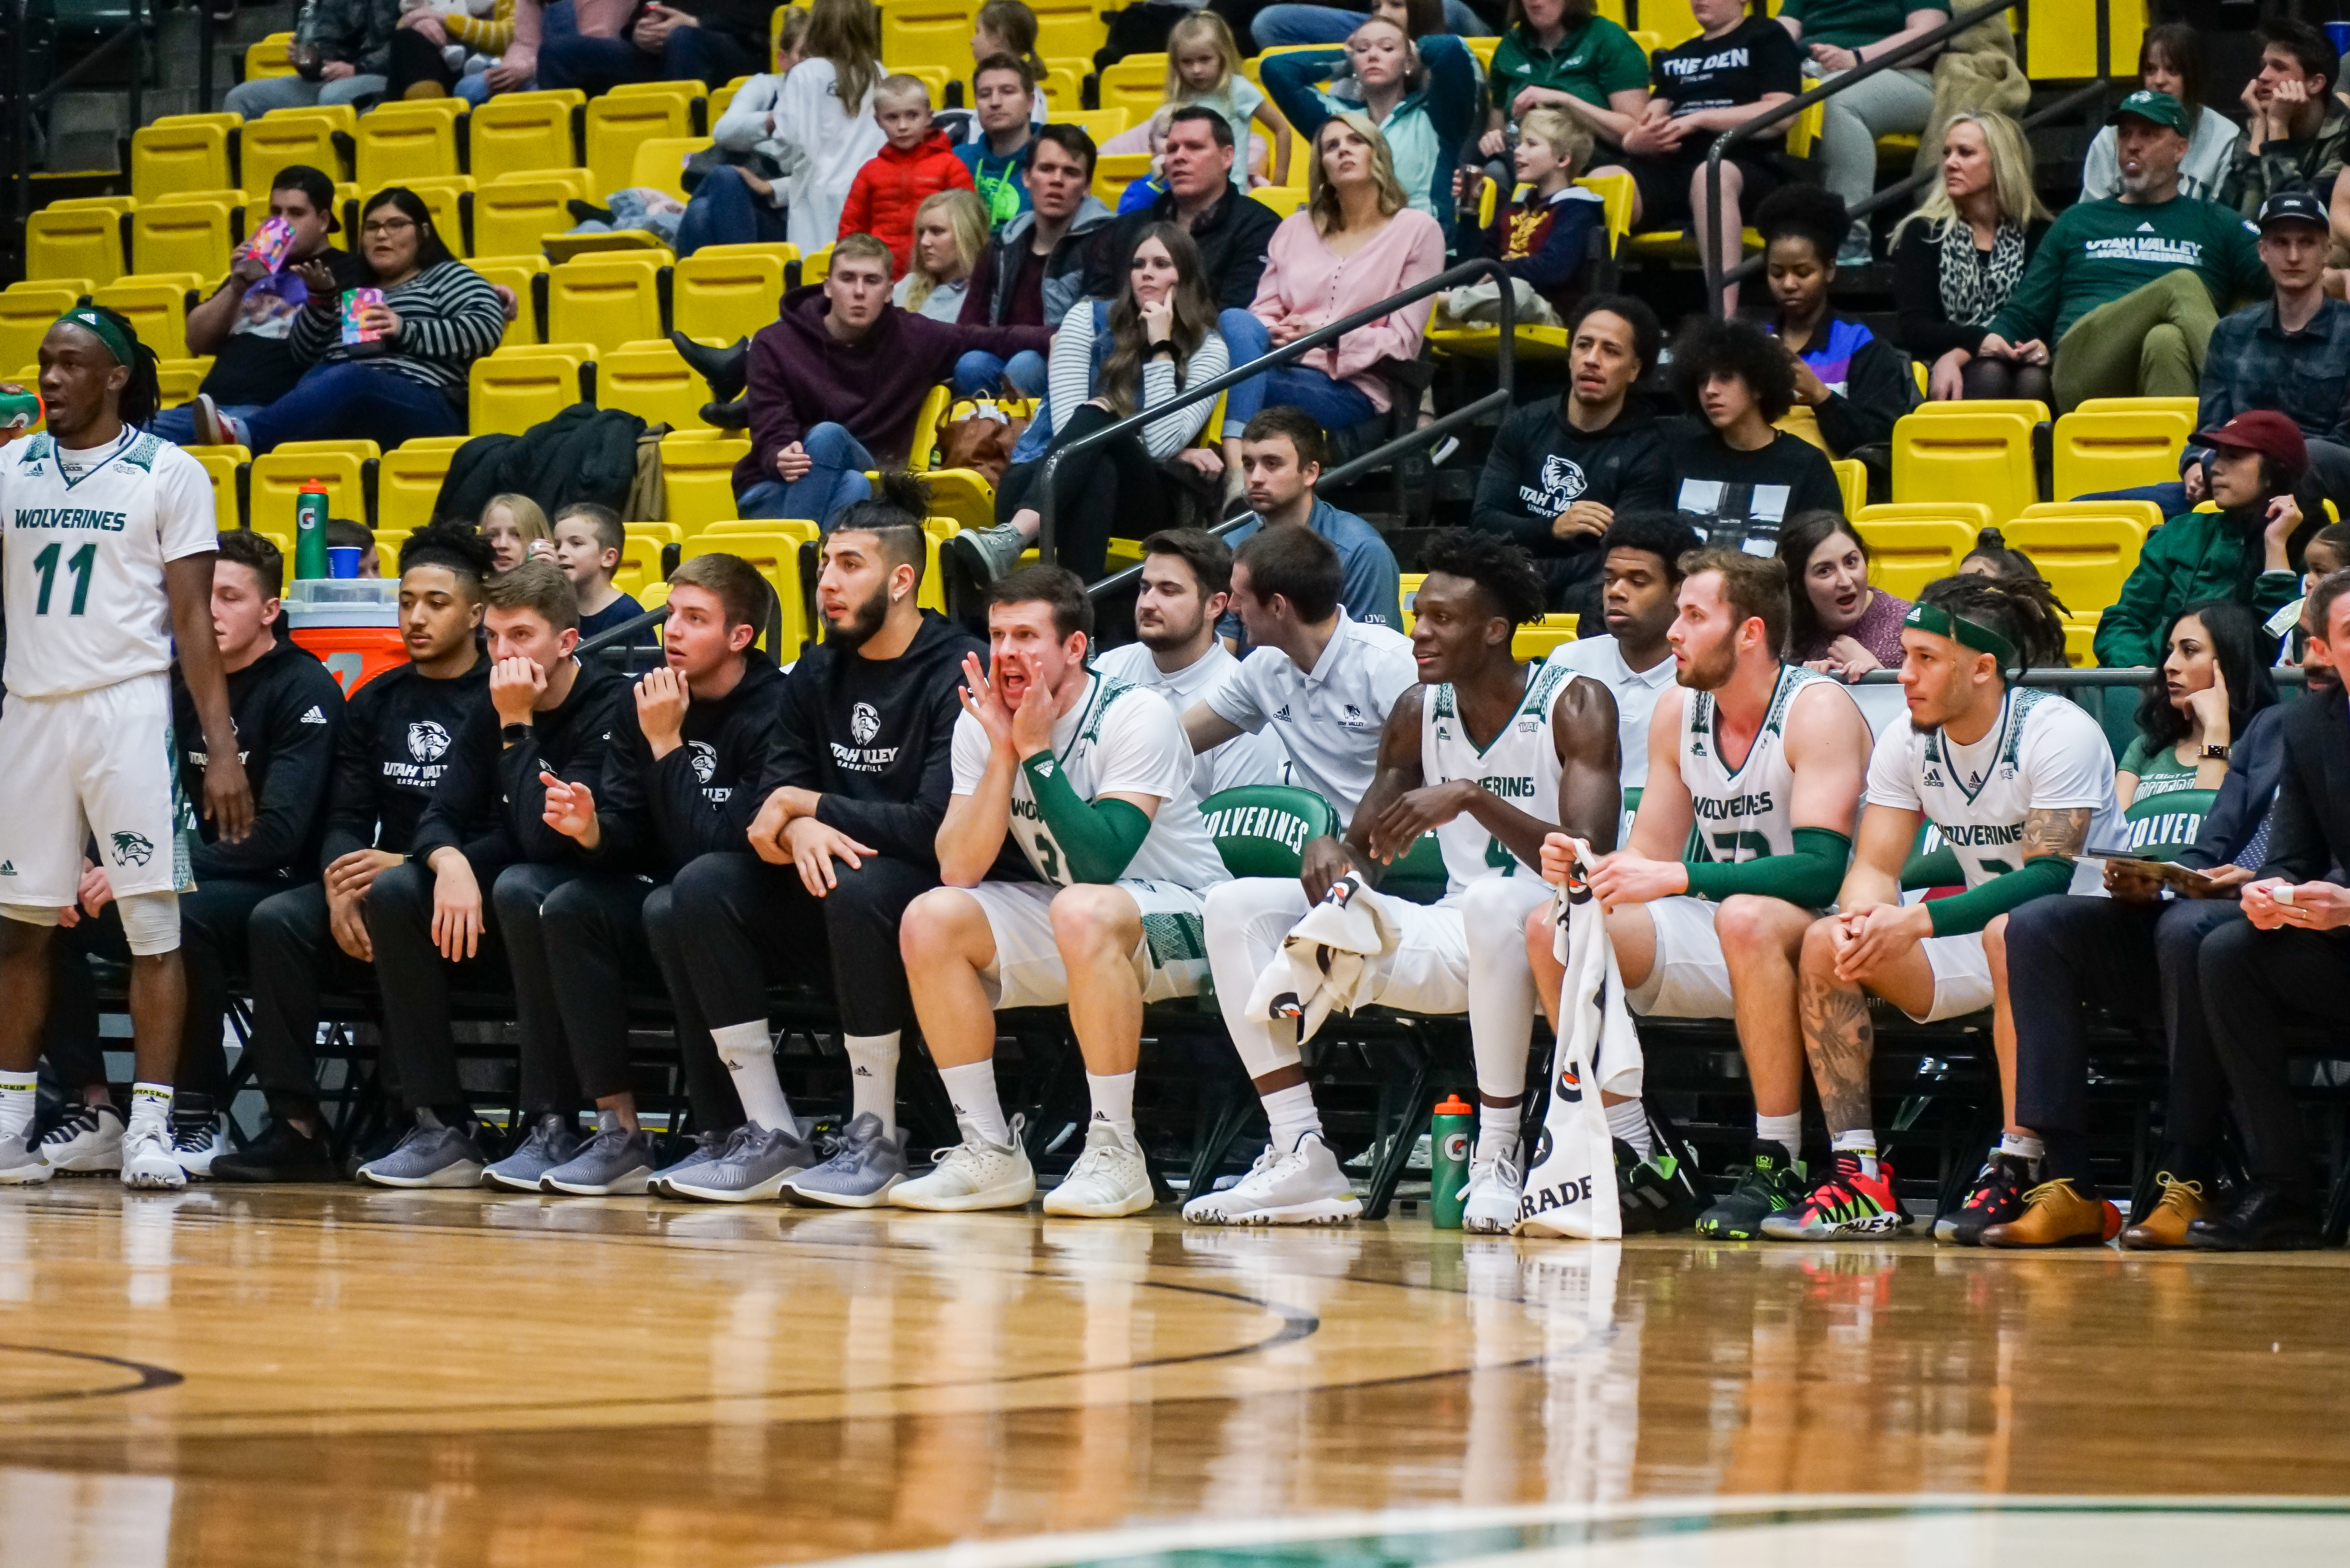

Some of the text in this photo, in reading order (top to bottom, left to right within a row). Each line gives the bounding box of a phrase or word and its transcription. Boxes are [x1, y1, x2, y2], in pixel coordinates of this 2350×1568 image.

[1662, 48, 1749, 76] THE DEN
[2086, 237, 2203, 257] UTAH VALLEY
[2097, 249, 2195, 265] WOLVERINES
[15, 509, 127, 532] WOLVERINES
[33, 541, 98, 617] 11
[383, 762, 421, 777] UTAH
[1484, 834, 1520, 877] 4
[1444, 1133, 1468, 1161] G
